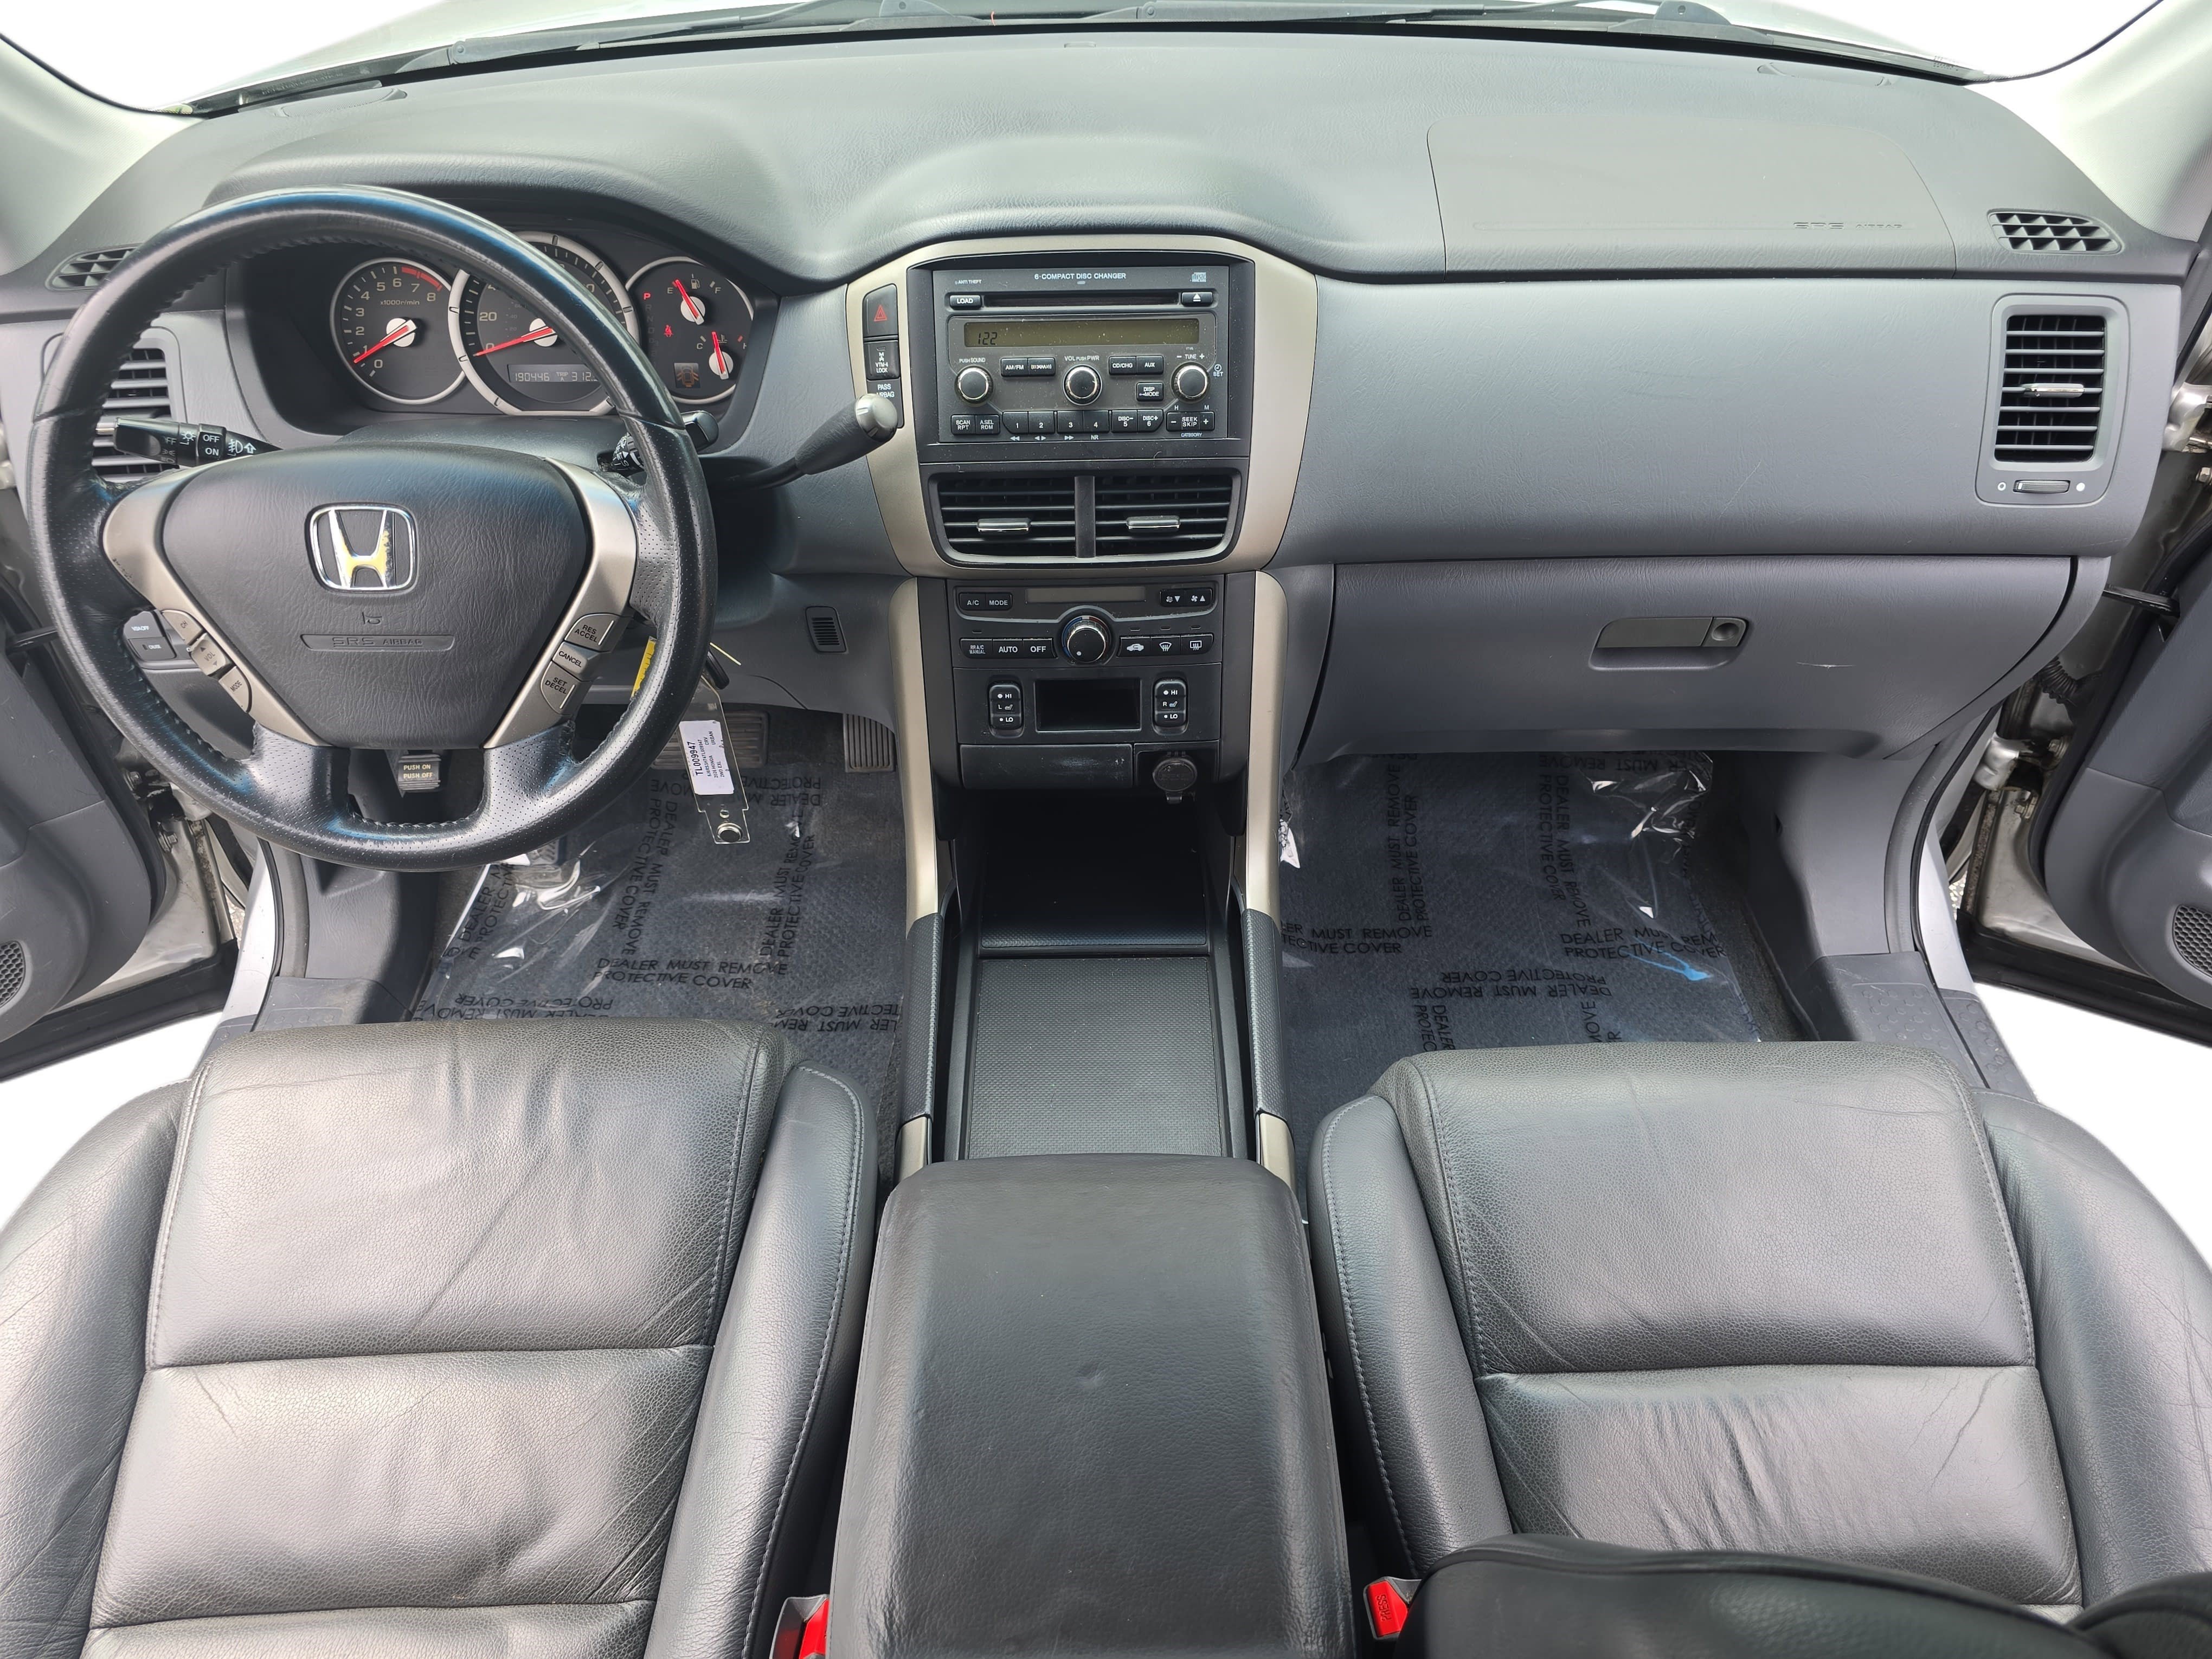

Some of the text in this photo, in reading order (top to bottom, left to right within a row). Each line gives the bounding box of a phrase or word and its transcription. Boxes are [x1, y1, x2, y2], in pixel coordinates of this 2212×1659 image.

[377, 282, 385, 291] 5
[393, 278, 402, 287] 6
[411, 284, 420, 292] 7
[361, 291, 370, 300] 4
[427, 293, 436, 301] 8
[356, 308, 364, 317] 3
[479, 312, 497, 321] 20
[356, 326, 364, 336] 2
[978, 332, 998, 345] 122
[374, 359, 383, 368] 0
[516, 372, 550, 382] 190446
[202, 434, 220, 443] OFF
[205, 447, 219, 456] ON
[180, 620, 188, 629] CH
[582, 624, 597, 634] RES
[332, 636, 374, 646] SRS
[574, 628, 597, 643] ACCEL
[204, 651, 216, 662] VOL
[558, 651, 582, 668] CANCEL
[229, 680, 242, 692] MODE
[544, 680, 567, 695] DECEL
[552, 677, 568, 686] SET
[686, 741, 704, 776] TL009947
[741, 776, 821, 790] PROTECTIVE
[770, 793, 821, 807] DEALER
[1387, 763, 1412, 922] DEALER MUST REMOVE
[1539, 774, 1566, 901] PROTECTIVE COVER
[1404, 794, 1430, 922] PROTECTIVE COVER
[1555, 775, 1591, 928] DEALER MUST REMOVE
[612, 799, 661, 931] PROTECTIVE COVER
[621, 801, 678, 955] DEALER MUST REMOVE
[777, 876, 805, 957] PROTECTIVE
[795, 834, 815, 873] COVER
[459, 886, 496, 942] DEALER
[760, 867, 791, 957] DEALER MUST
[1311, 925, 1433, 940] MUST REMOVE
[1559, 927, 1624, 945] DEALER
[1342, 942, 1403, 954] COVER
[1564, 941, 1727, 959] PROTECTIVE COVER
[596, 958, 659, 971] DEALER
[666, 960, 711, 971] MUST
[592, 971, 754, 989] PROTECTIVE COVER
[1439, 968, 1607, 985] PROTECTIVE COVER
[1410, 983, 1612, 999] DEALER MUST REMOVE
[455, 993, 514, 1007] COVER
[775, 1005, 834, 1019] COVER
[817, 1018, 862, 1032] MUST
[1431, 1005, 1456, 1050] DEALER
[1376, 1594, 1393, 1621] PRESS
